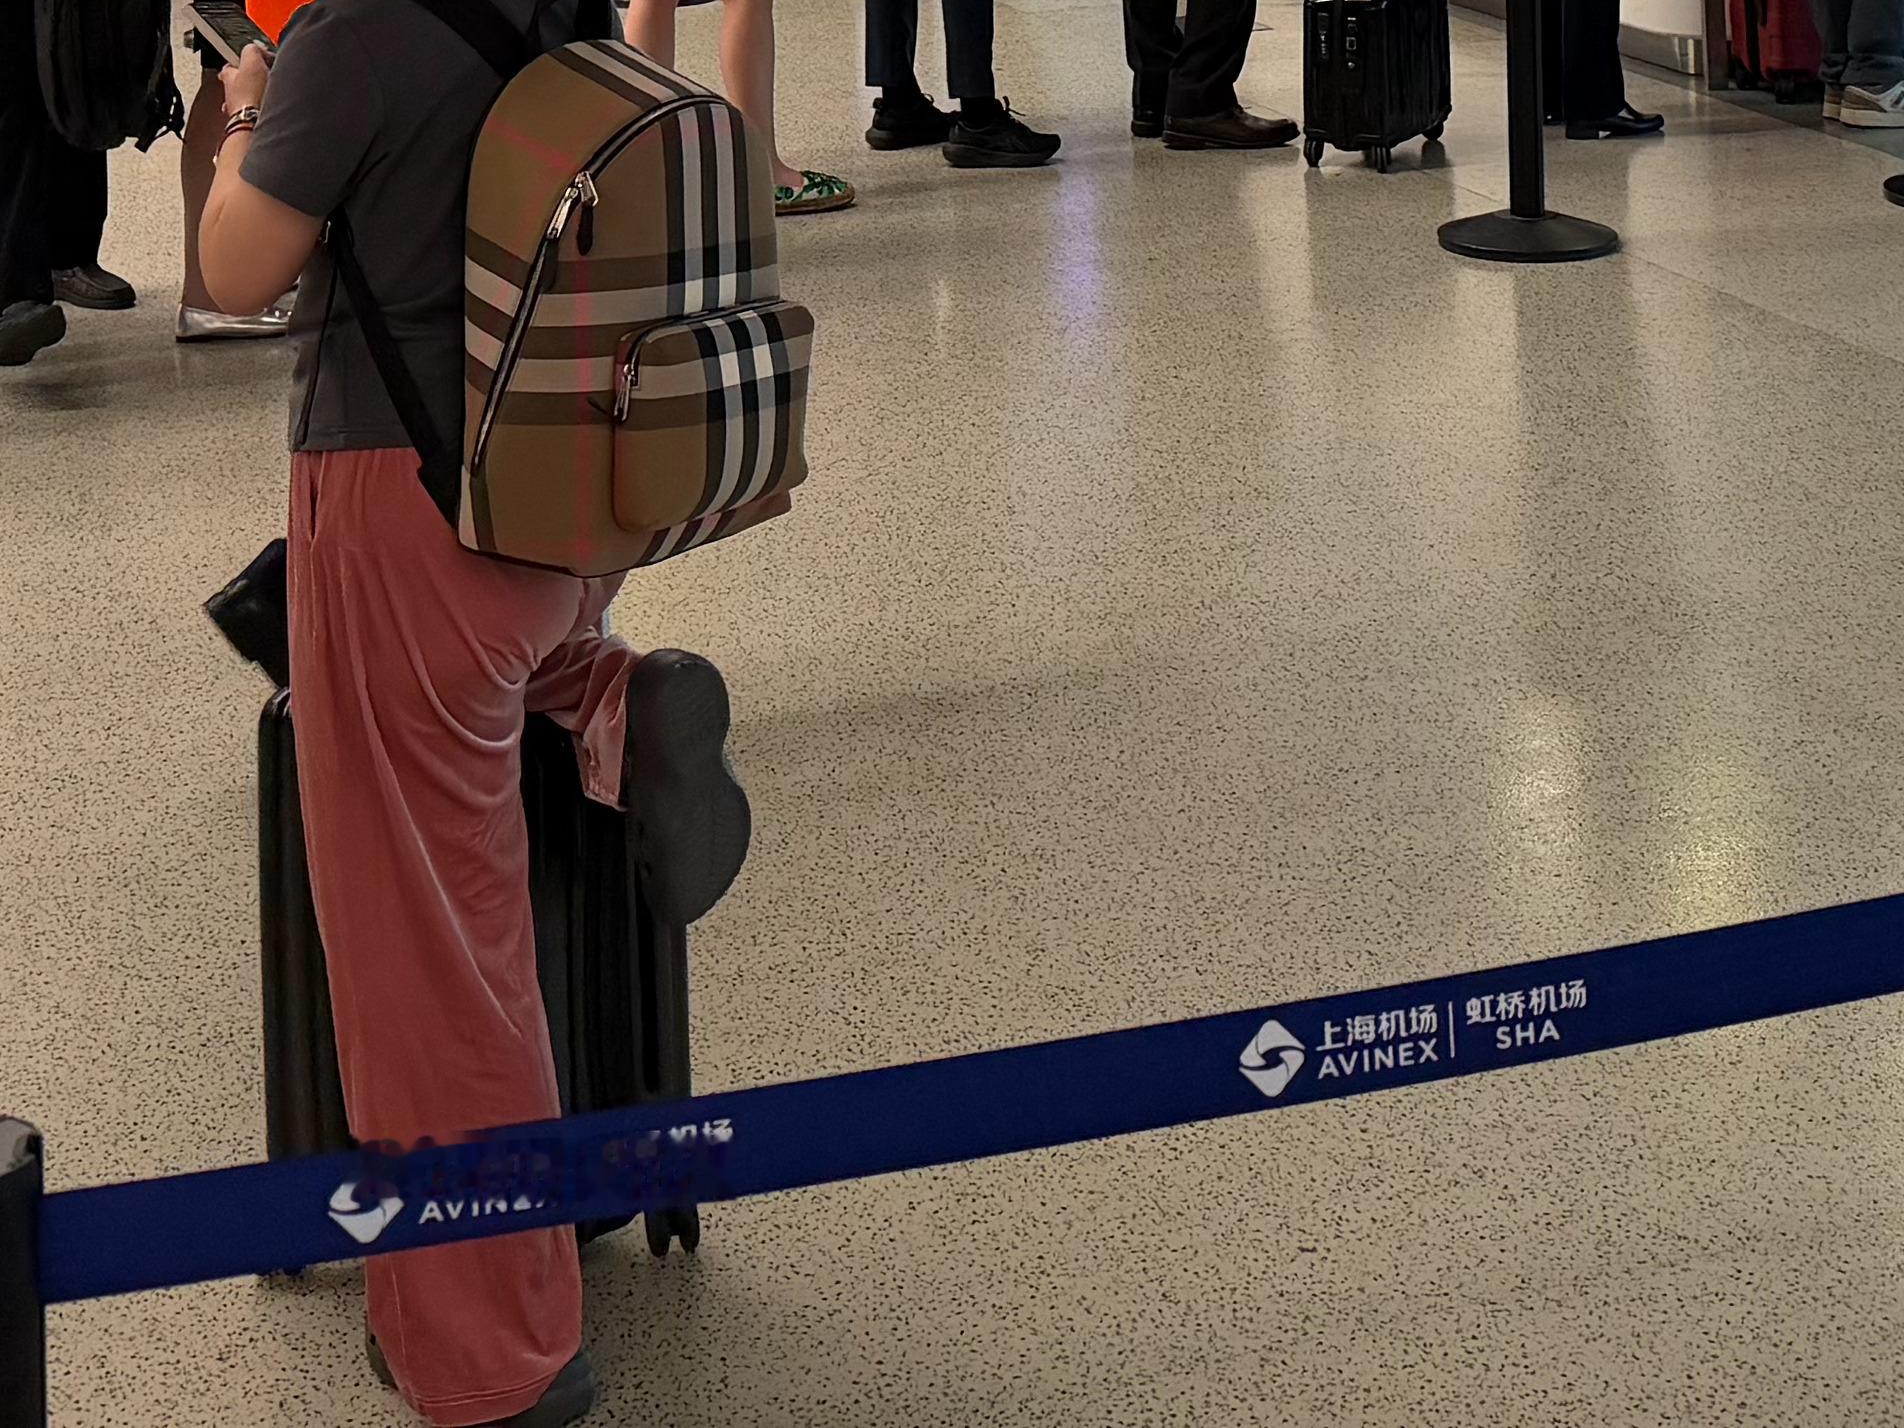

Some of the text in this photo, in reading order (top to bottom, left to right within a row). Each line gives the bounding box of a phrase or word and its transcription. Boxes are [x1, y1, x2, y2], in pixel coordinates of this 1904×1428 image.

[1315, 978, 1588, 1053] 上海机场 虹桥机场
[1317, 1018, 1561, 1080] AVINEX SHA
